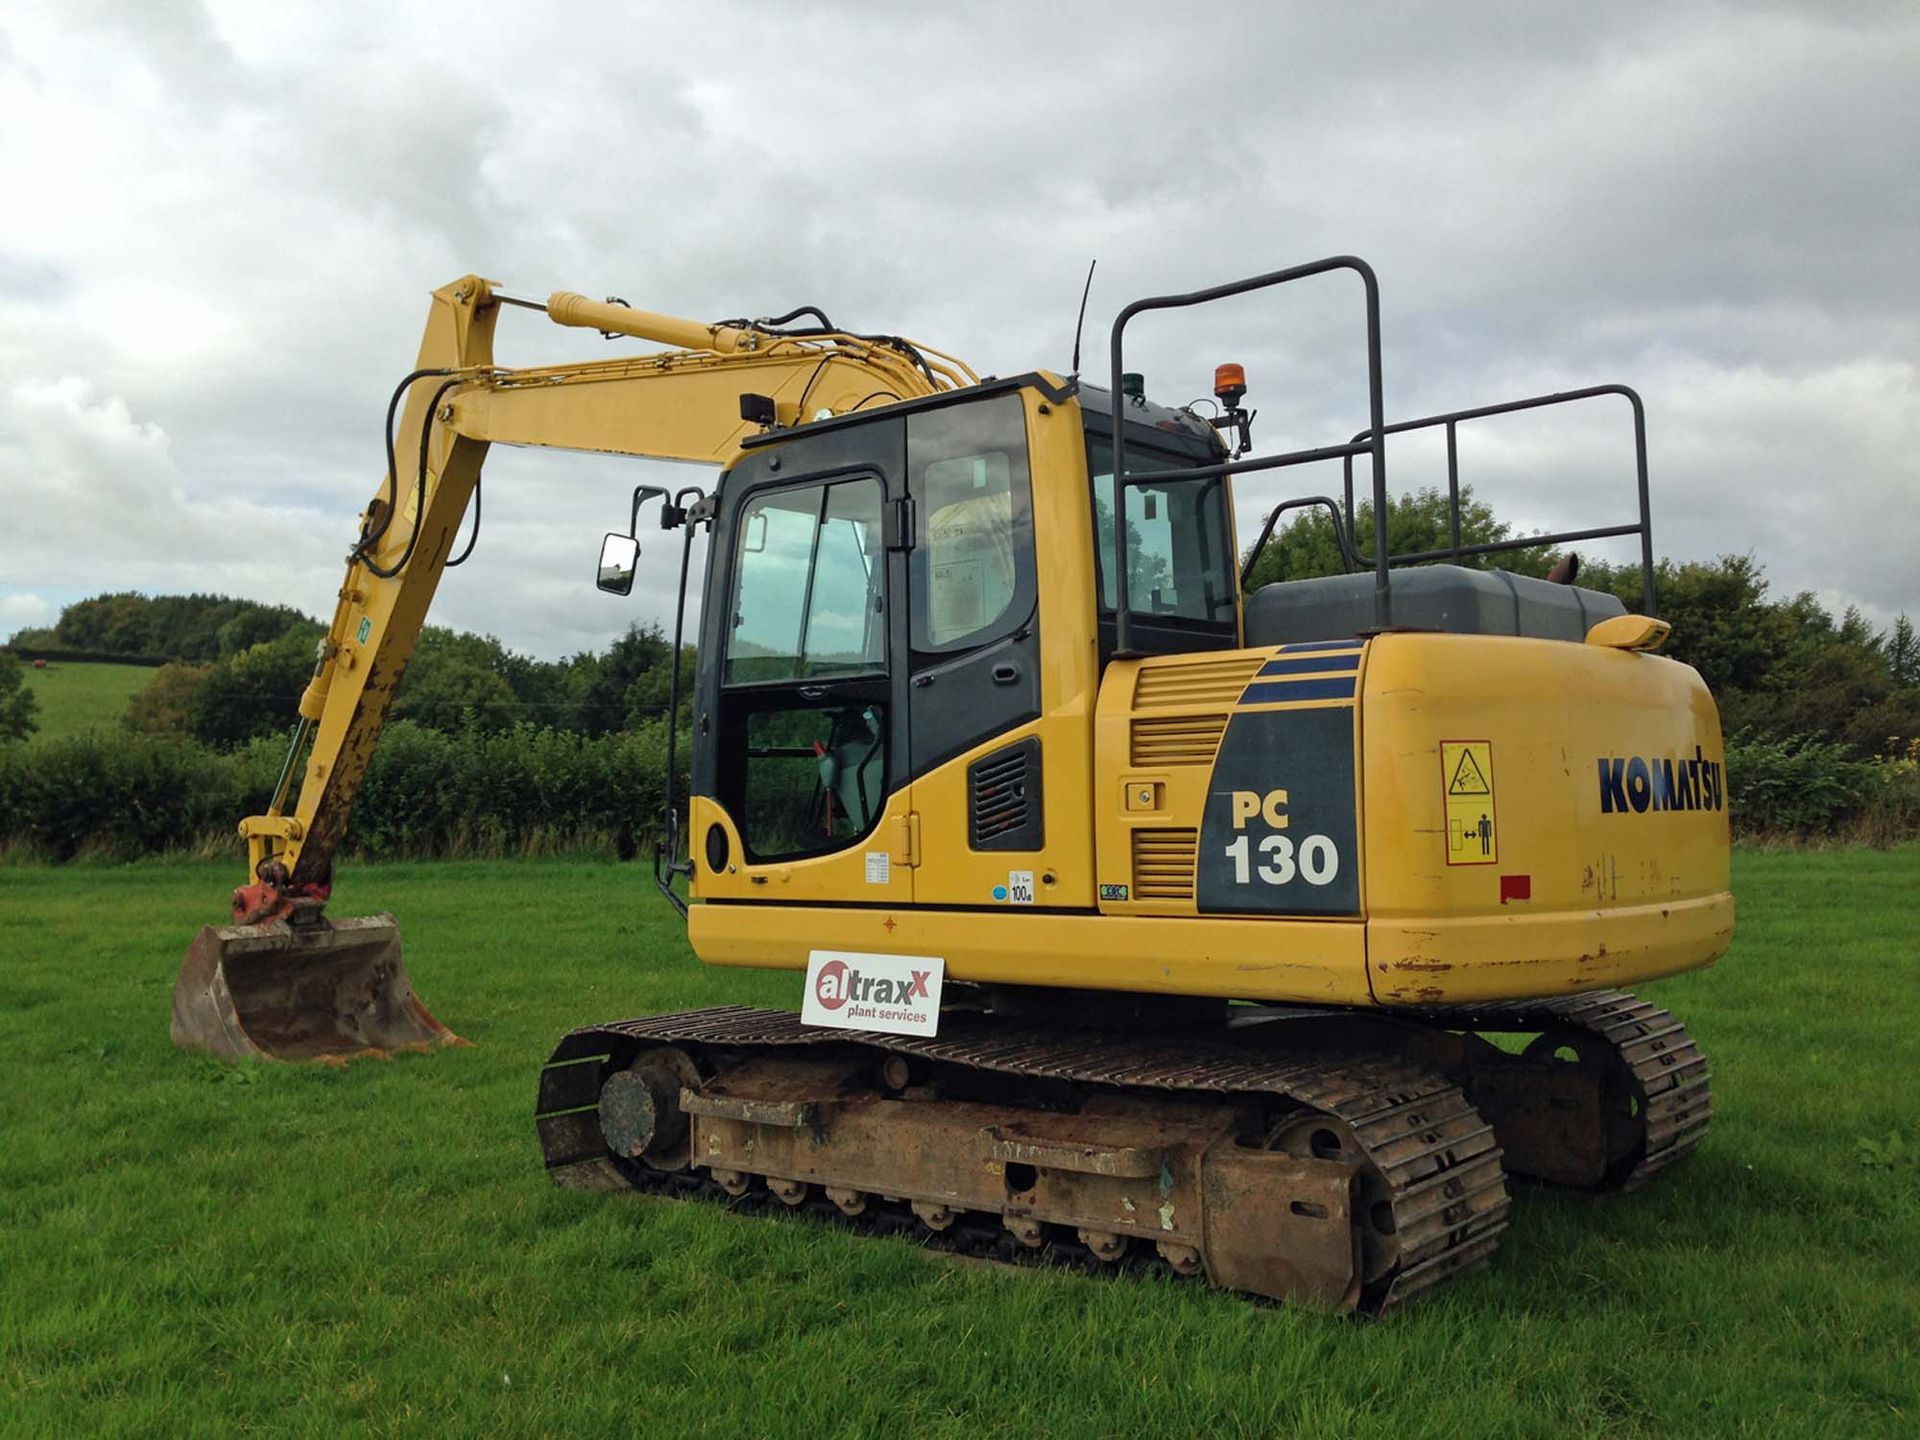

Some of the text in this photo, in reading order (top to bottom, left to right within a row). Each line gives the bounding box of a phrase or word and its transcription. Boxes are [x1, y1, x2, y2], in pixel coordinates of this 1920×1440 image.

[1598, 745, 1722, 814] KOMATSU
[1232, 789, 1289, 829] PC
[1225, 834, 1339, 886] 130
[847, 1004, 927, 1023] plant services
